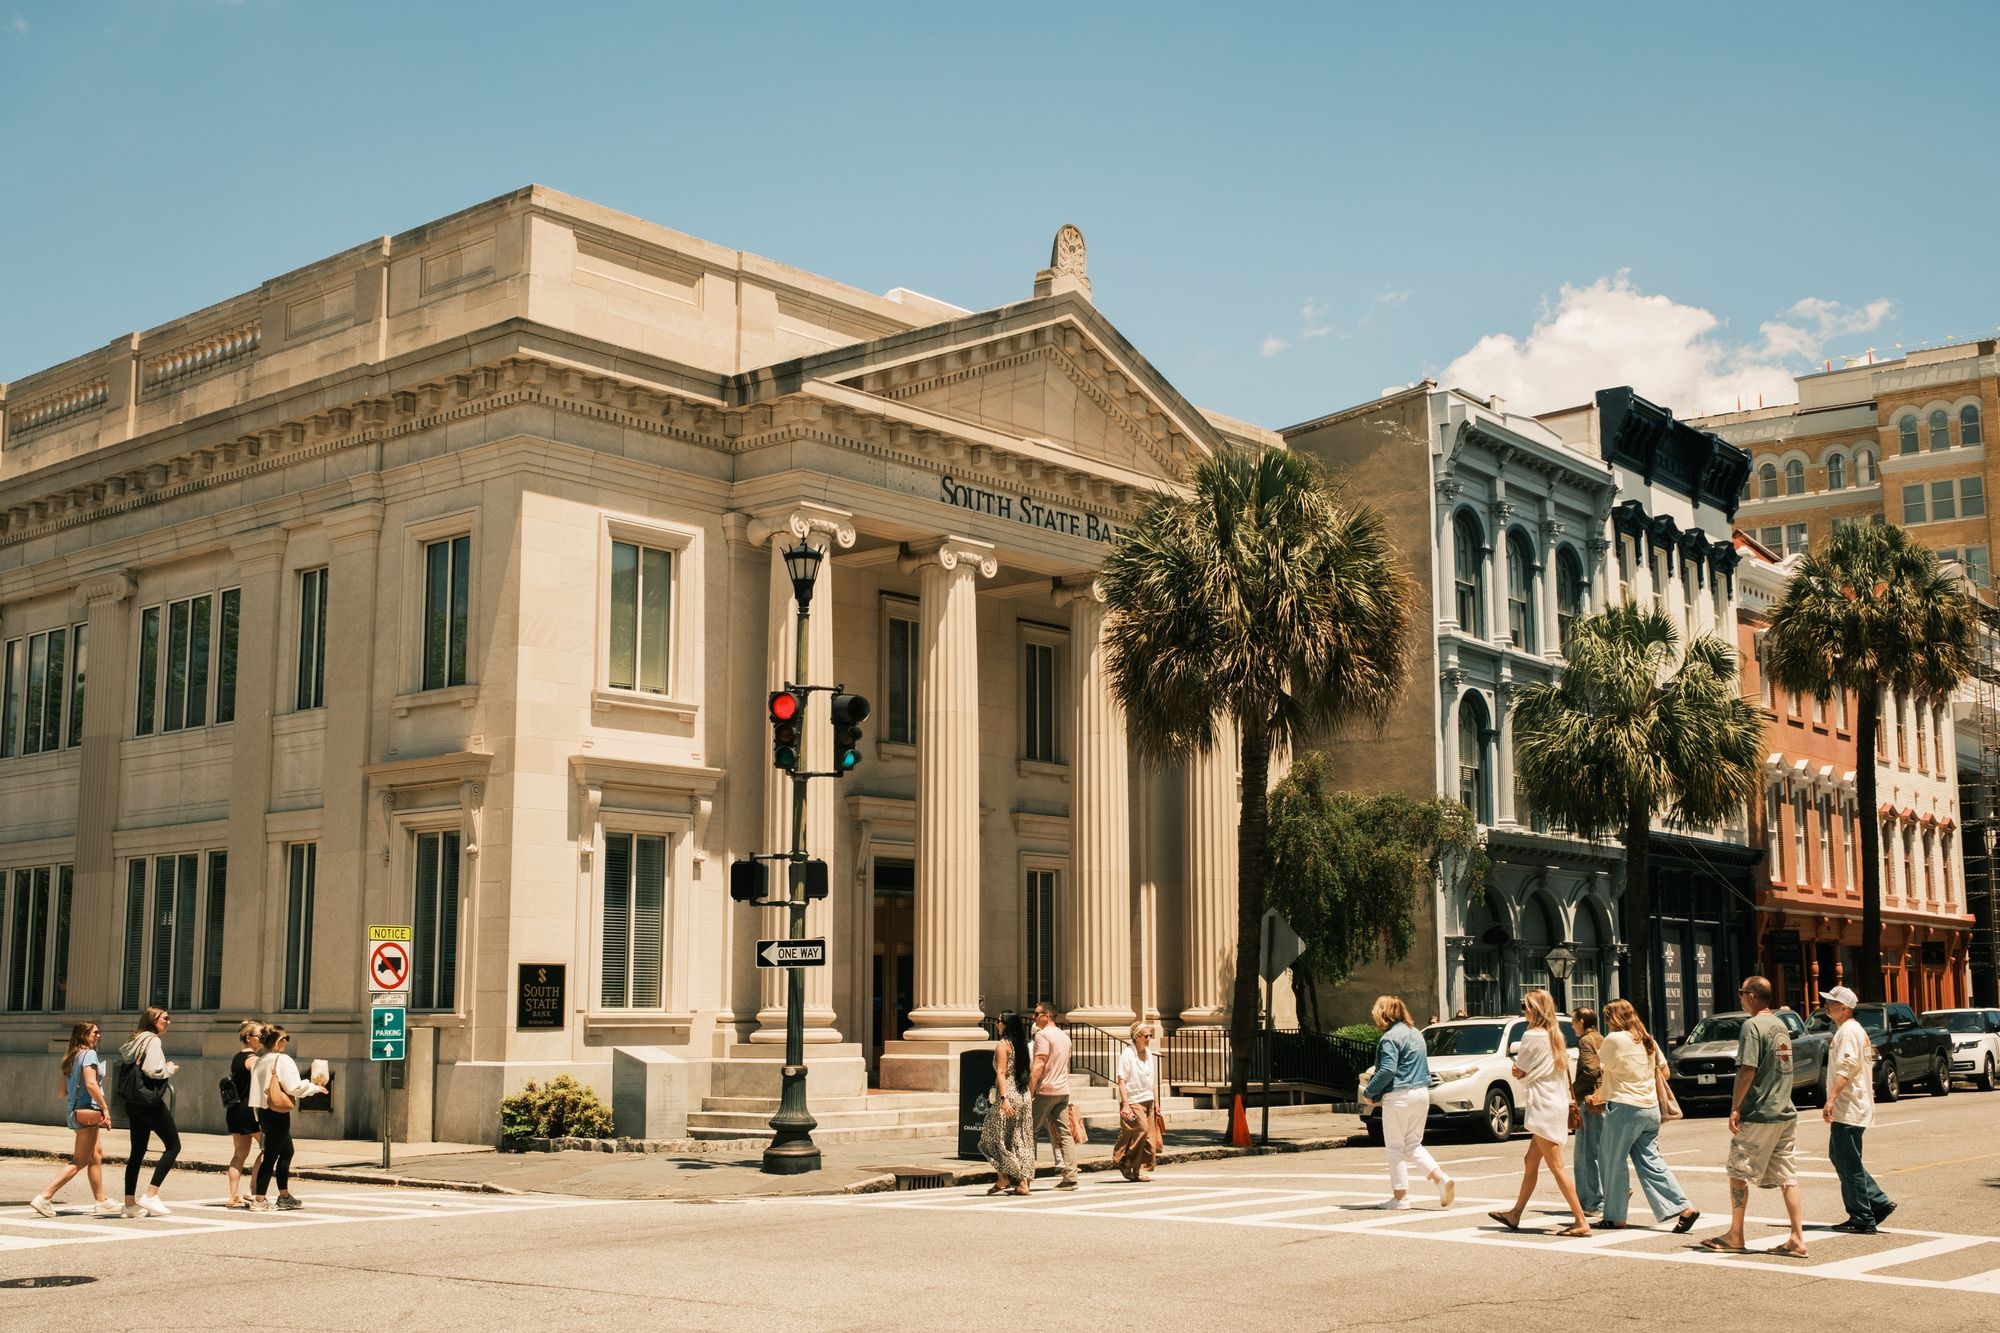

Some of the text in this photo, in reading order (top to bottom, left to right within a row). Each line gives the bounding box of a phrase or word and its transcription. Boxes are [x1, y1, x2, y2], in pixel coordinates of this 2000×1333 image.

[941, 475, 1129, 545] SOUTH STATE BA
[374, 928, 406, 939] NOTICE
[778, 947, 819, 959] ONE WAY
[524, 983, 560, 997] SOUTH
[525, 998, 558, 1012] STATE
[384, 1013, 394, 1026] P
[375, 1029, 402, 1037] PARKING
